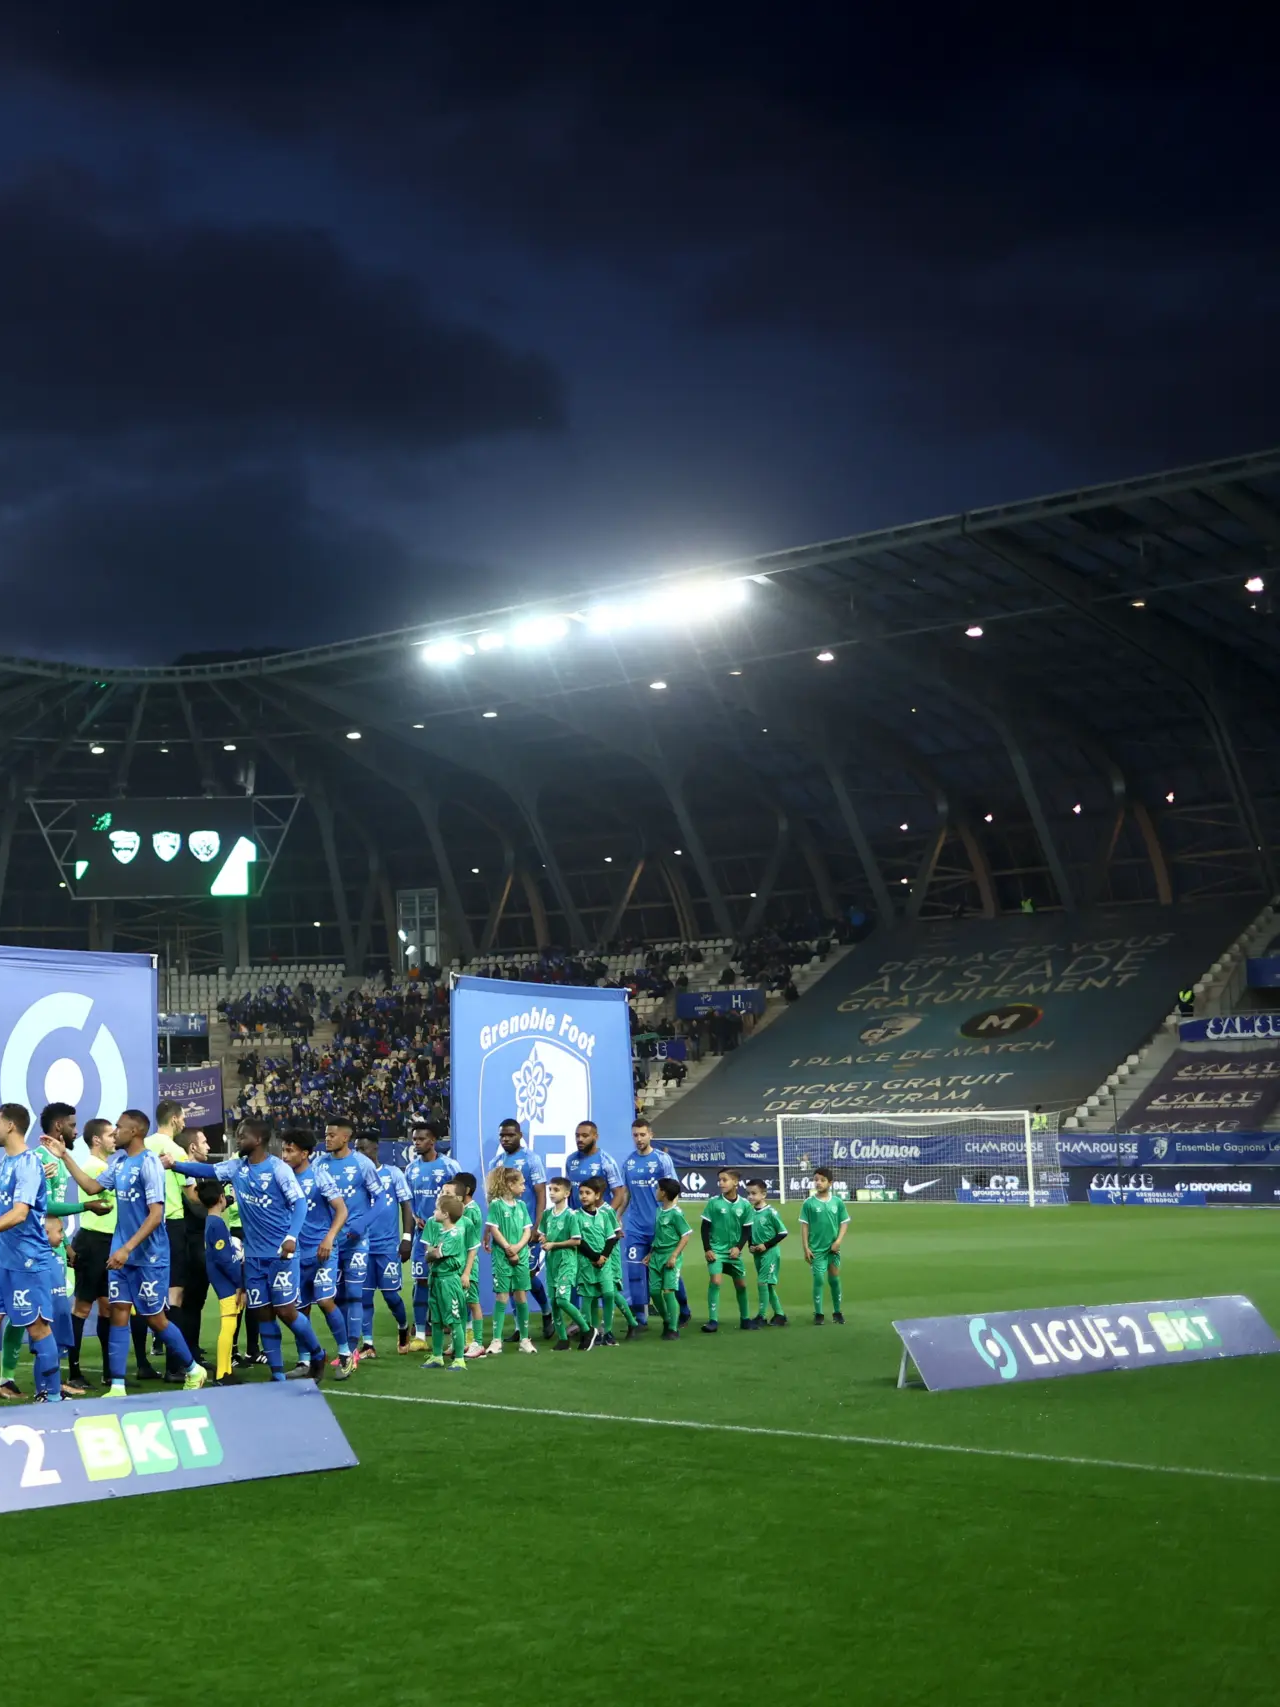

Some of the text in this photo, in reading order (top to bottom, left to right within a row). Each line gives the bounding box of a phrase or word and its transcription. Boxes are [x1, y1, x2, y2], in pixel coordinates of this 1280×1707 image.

[850, 949, 1158, 995] AU STADE
[837, 973, 1140, 1011] GRATUITEMENT
[480, 1006, 556, 1050] Grenoble
[558, 1013, 596, 1057] Foot
[977, 1014, 1022, 1030] M
[801, 1051, 895, 1067] PLACE
[898, 1048, 942, 1061] DE
[945, 1040, 1055, 1057] MATCH
[158, 1084, 216, 1097] LPES AUTO
[778, 1080, 879, 1097] TICKET
[882, 1072, 1015, 1090] GRATUIT
[763, 1099, 803, 1112] DE
[690, 1152, 726, 1162] ALPES AUTO
[833, 1139, 920, 1159] le Cabanon
[1055, 1141, 1139, 1154] CHAMROUSSE
[1175, 1142, 1221, 1152] Ensemble
[1223, 1142, 1267, 1154] Gagnons
[1089, 1173, 1154, 1191] SAMSE
[1190, 1182, 1252, 1192] provencia
[1011, 1315, 1216, 1366] LIGUE 2 BKT
[0, 1424, 62, 1488] 2
[79, 1414, 214, 1471] BKT
